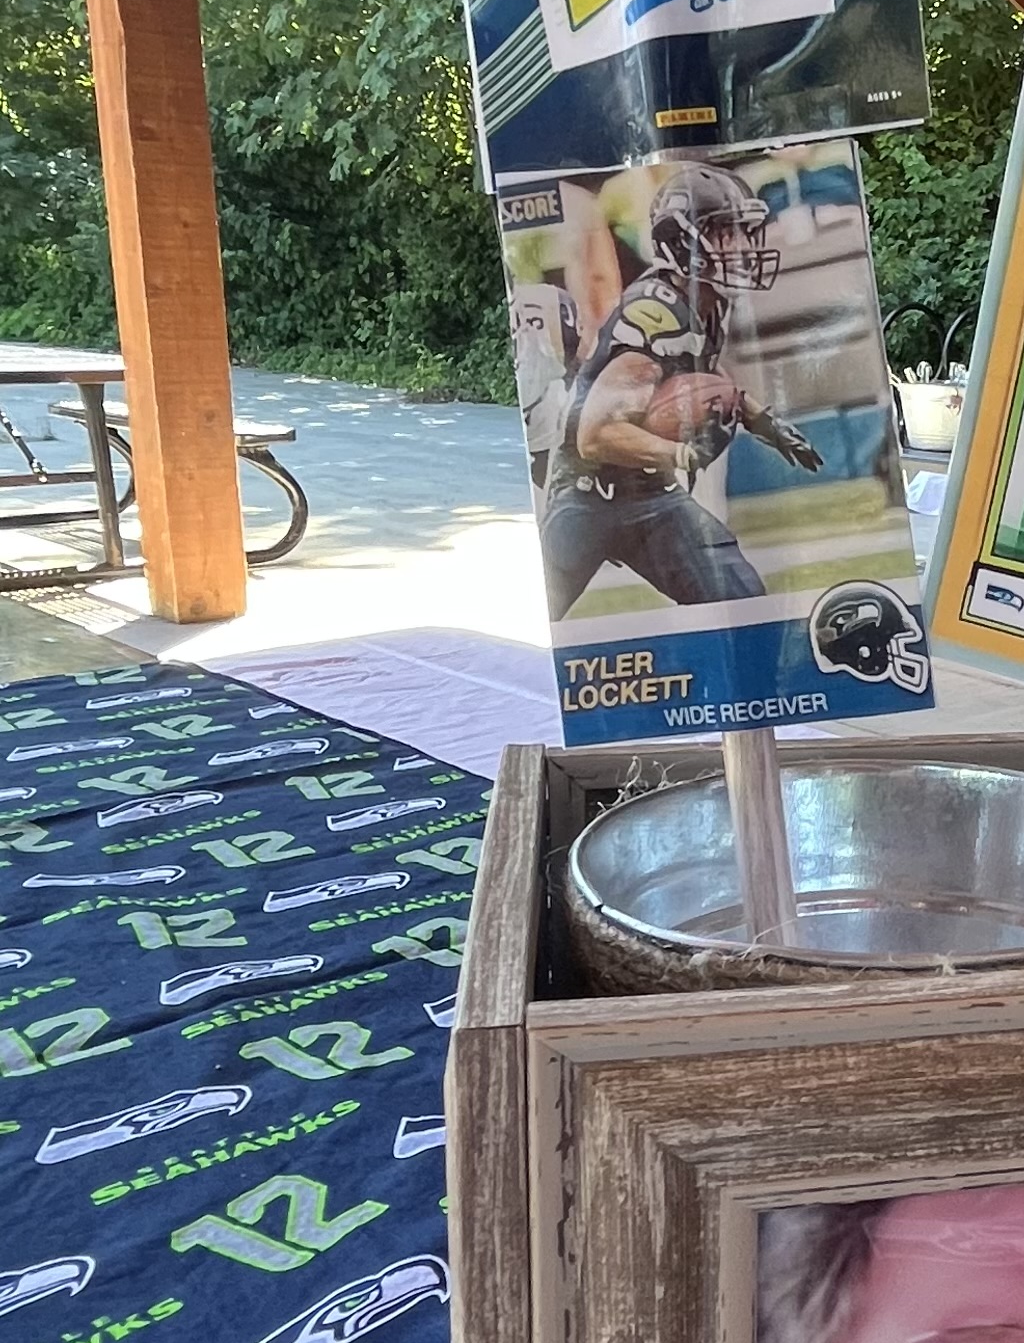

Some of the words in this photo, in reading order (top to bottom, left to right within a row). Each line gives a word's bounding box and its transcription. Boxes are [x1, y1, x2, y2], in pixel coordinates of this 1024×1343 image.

[500, 190, 561, 224] SCORE
[564, 651, 654, 684] TYLER
[563, 673, 693, 713] LOCKETT
[663, 702, 719, 728] WIDE
[721, 692, 829, 724] RECEIVER
[131, 714, 236, 741] 12
[77, 766, 200, 795] 12
[285, 770, 385, 801] 12
[191, 831, 316, 868] 12
[117, 909, 248, 949] 12
[181, 971, 388, 1039] SEAHAWKS
[238, 1021, 416, 1081] 12
[90, 1099, 361, 1206] SEAHAWKS
[170, 1174, 390, 1273] 12
